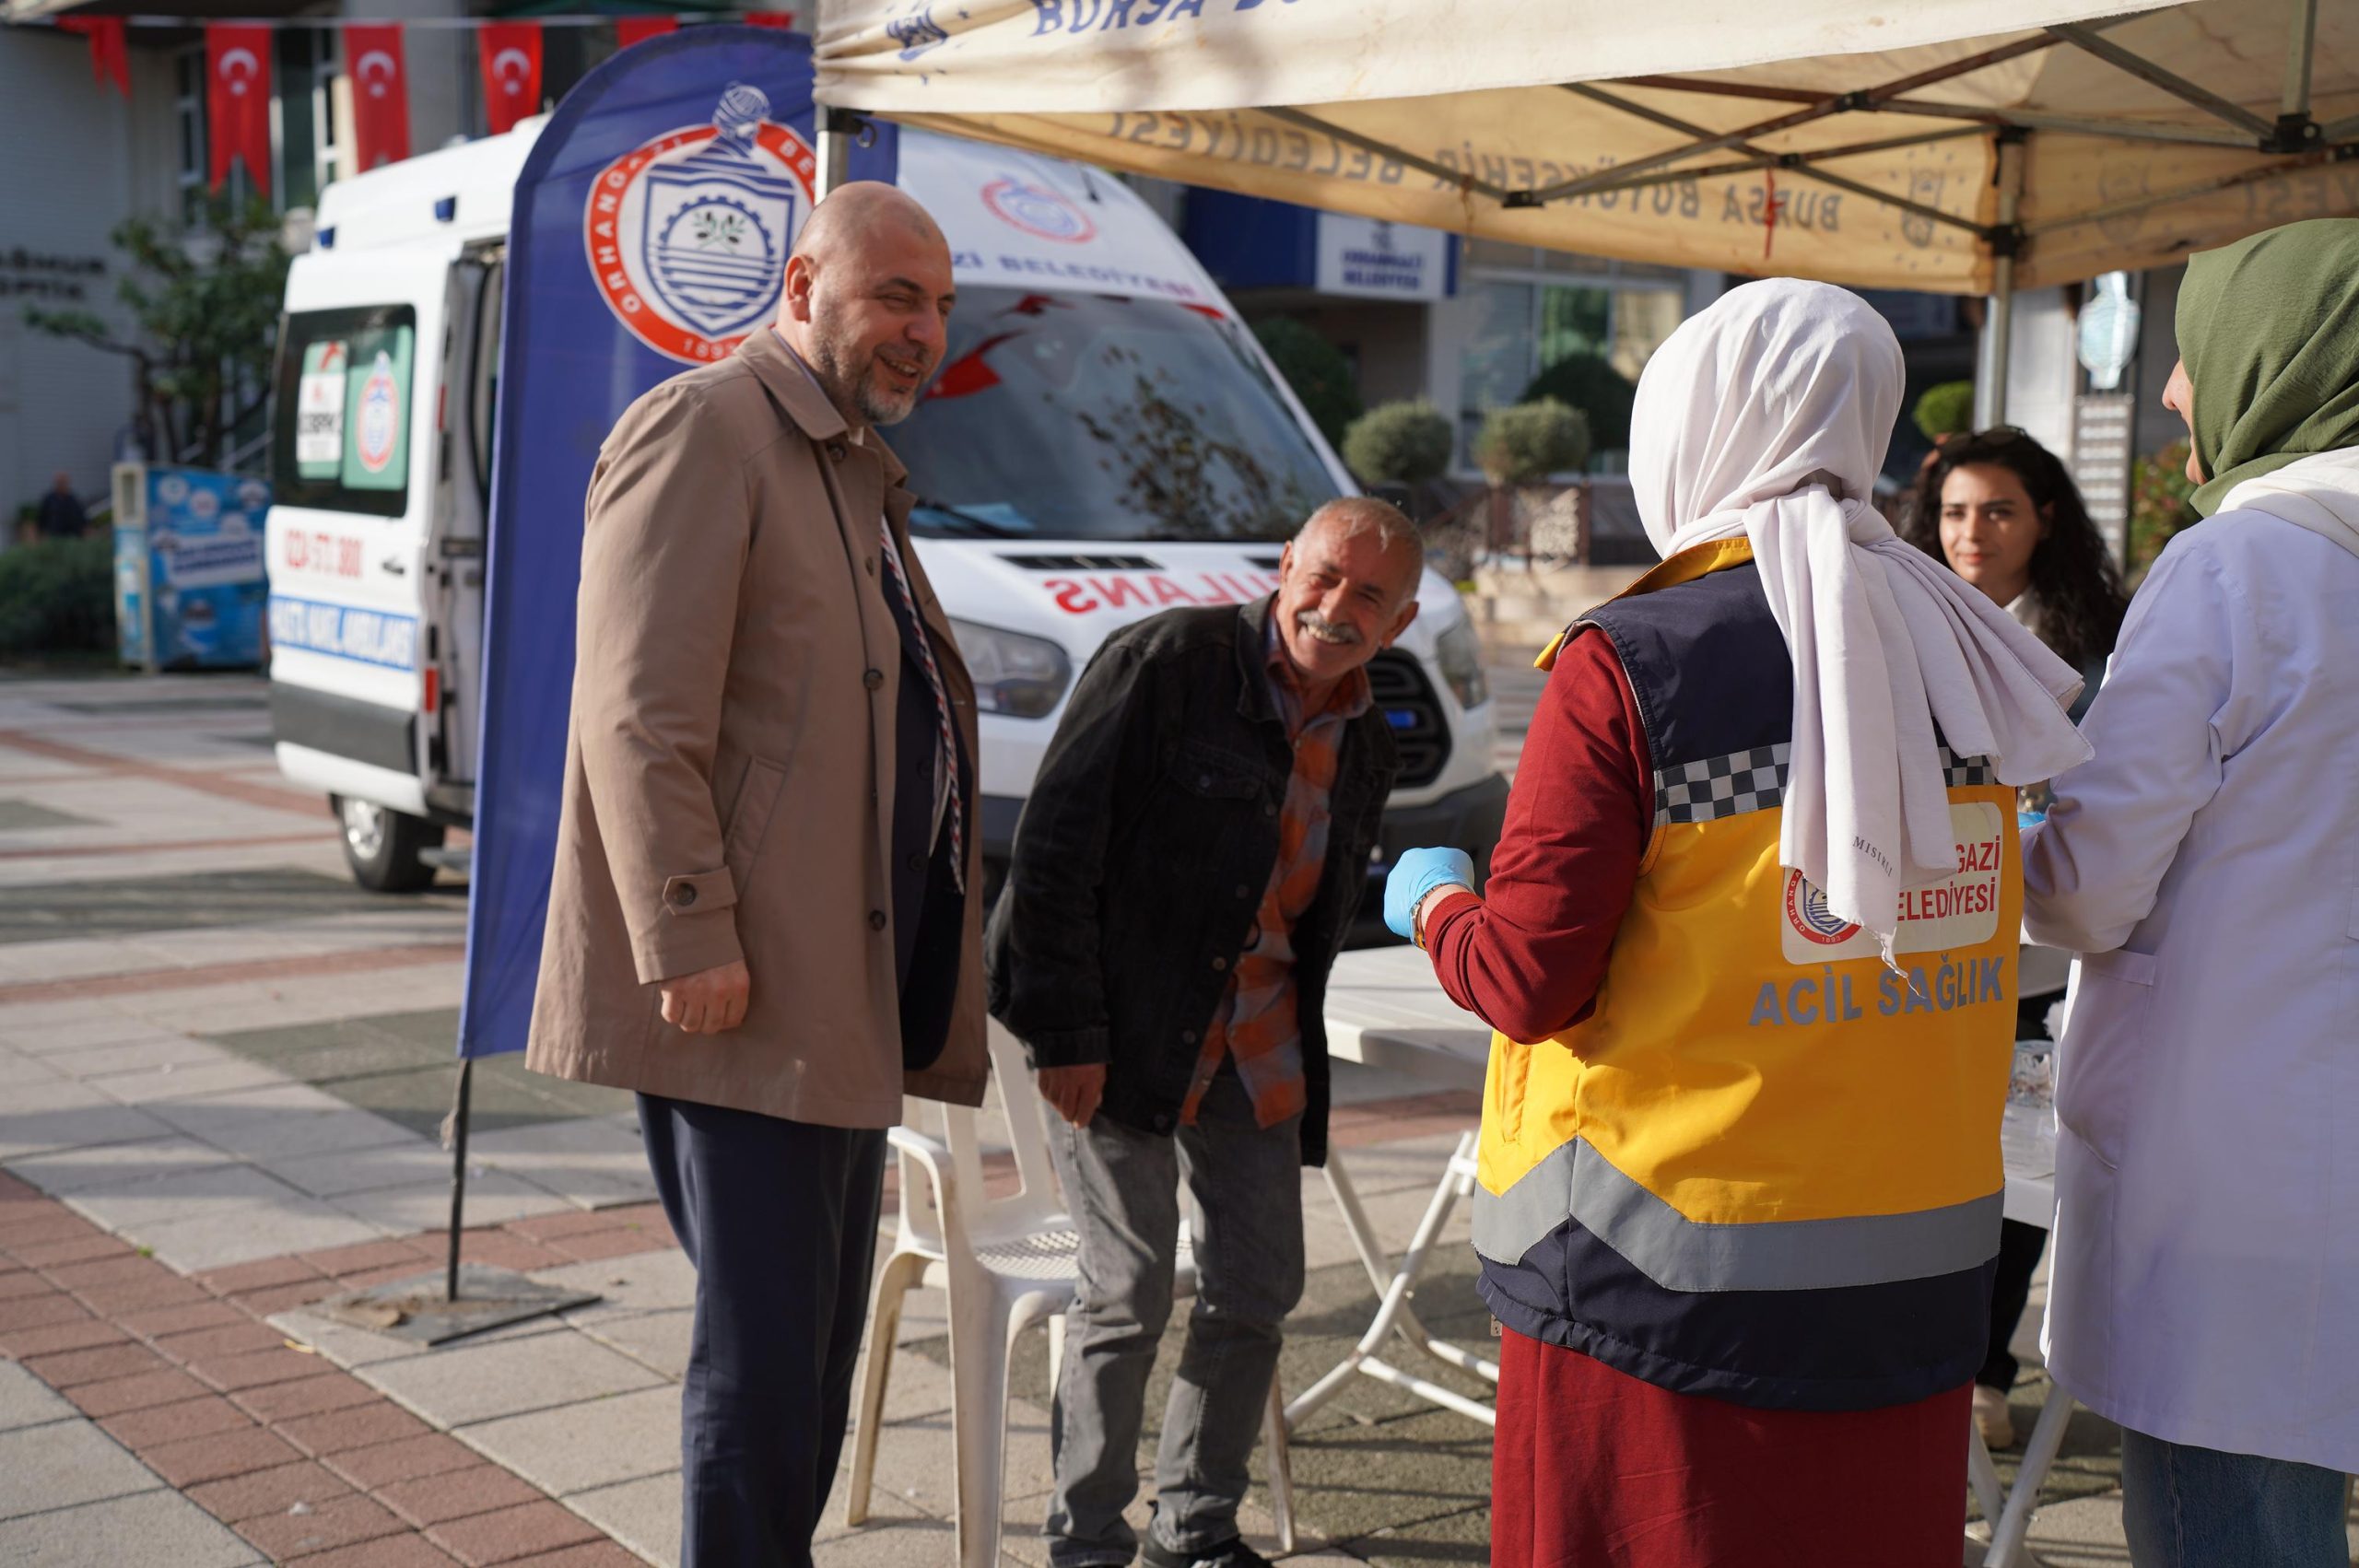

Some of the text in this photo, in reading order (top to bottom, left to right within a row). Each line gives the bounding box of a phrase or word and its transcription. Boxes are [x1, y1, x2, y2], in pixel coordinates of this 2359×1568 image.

[1955, 835, 2001, 874] GAZİ
[1897, 876, 1996, 922] LEDİYESİ
[1748, 953, 2005, 1026] ACİL SAĞLIK
